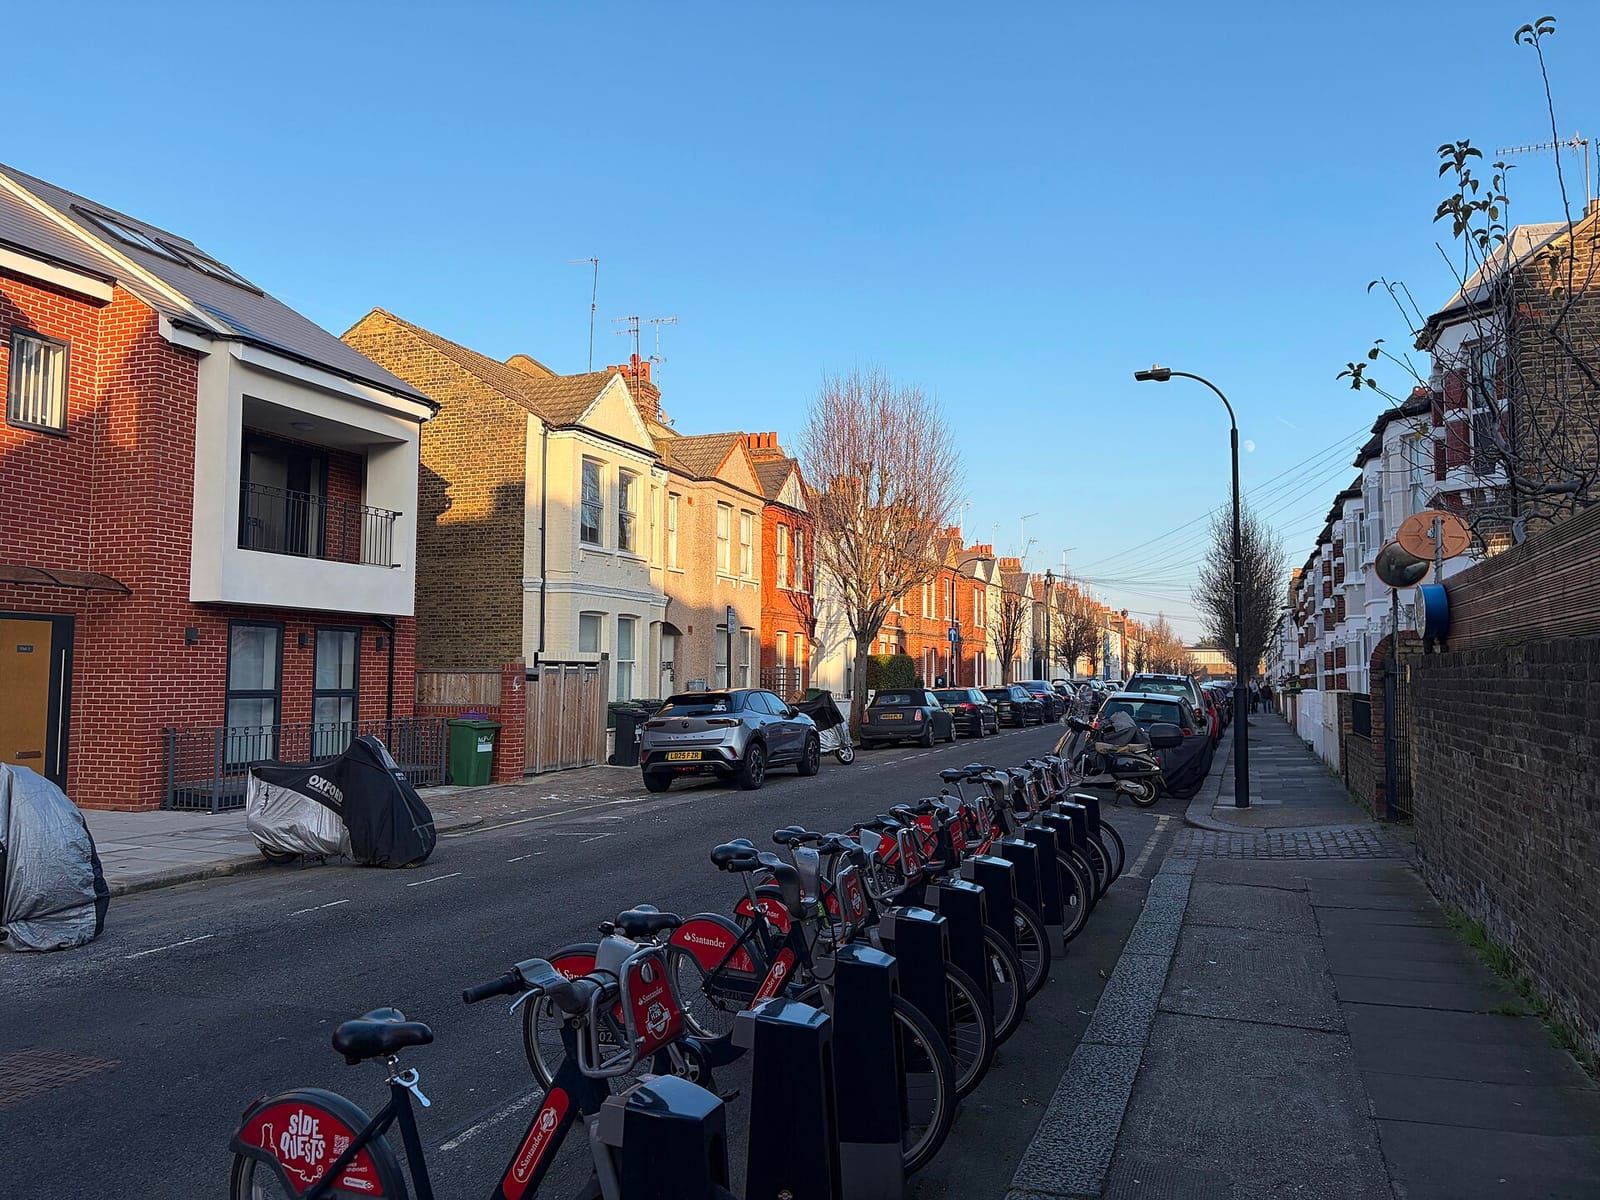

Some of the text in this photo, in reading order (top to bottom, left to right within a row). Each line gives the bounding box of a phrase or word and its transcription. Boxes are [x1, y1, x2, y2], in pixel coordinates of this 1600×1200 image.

[308, 774, 344, 803] OXFORD
[690, 932, 726, 948] Santander
[642, 986, 664, 1004] Santander
[288, 1109, 324, 1139] SIDE
[280, 1131, 326, 1166] QUESTS
[520, 1131, 544, 1170] Santander
